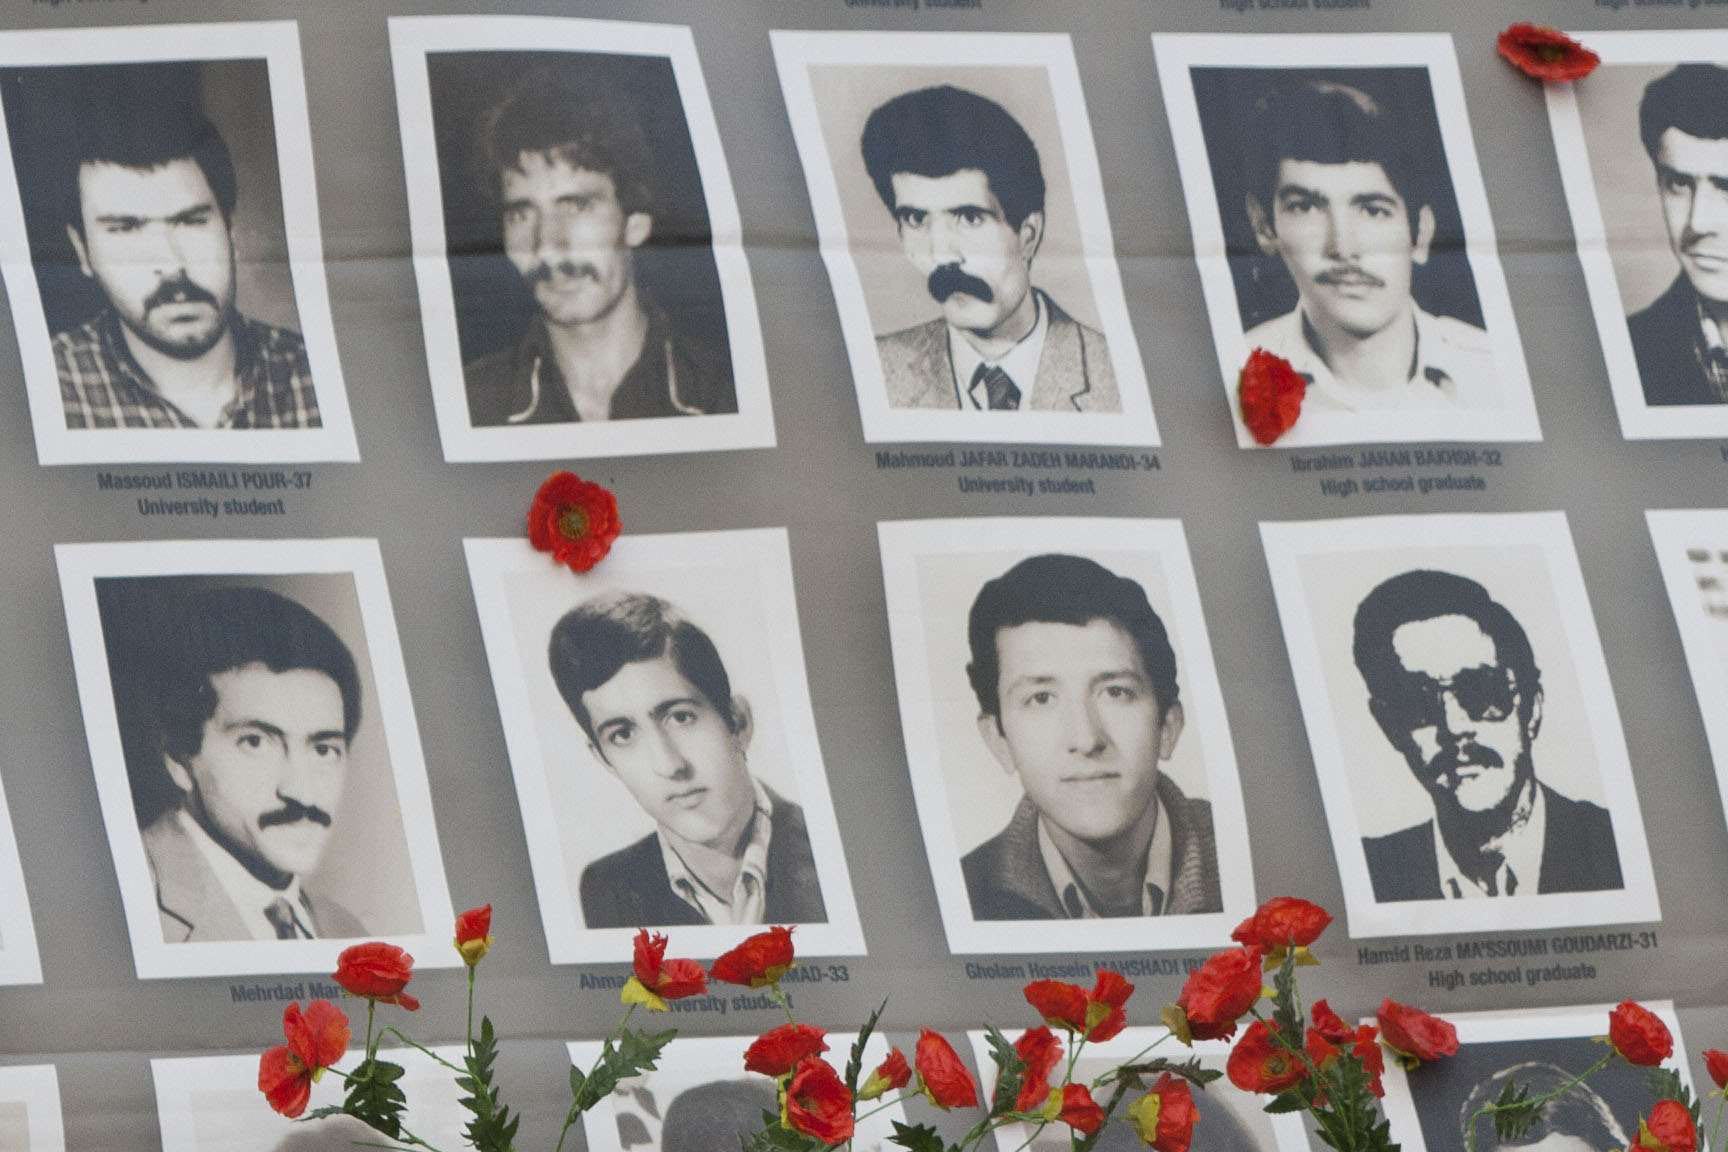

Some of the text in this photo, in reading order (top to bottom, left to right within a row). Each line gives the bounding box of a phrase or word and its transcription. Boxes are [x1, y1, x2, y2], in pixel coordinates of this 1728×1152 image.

[876, 451, 1161, 471] Mahmoud JAFAR ZADEH MARANDI-34
[98, 470, 313, 490] Massoud ISMAILI POUR-37
[958, 476, 1096, 495] University student
[1320, 475, 1486, 498] High school graduate
[138, 498, 285, 517] University student
[1357, 945, 1410, 965] Hamid
[1414, 943, 1453, 962] Reza
[1550, 931, 1658, 955] GOUDARZI-31
[964, 961, 1025, 980] Gholam
[1028, 959, 1091, 979] Hossein
[1428, 961, 1597, 992] High school graduate
[229, 983, 305, 1002] Mehrdad
